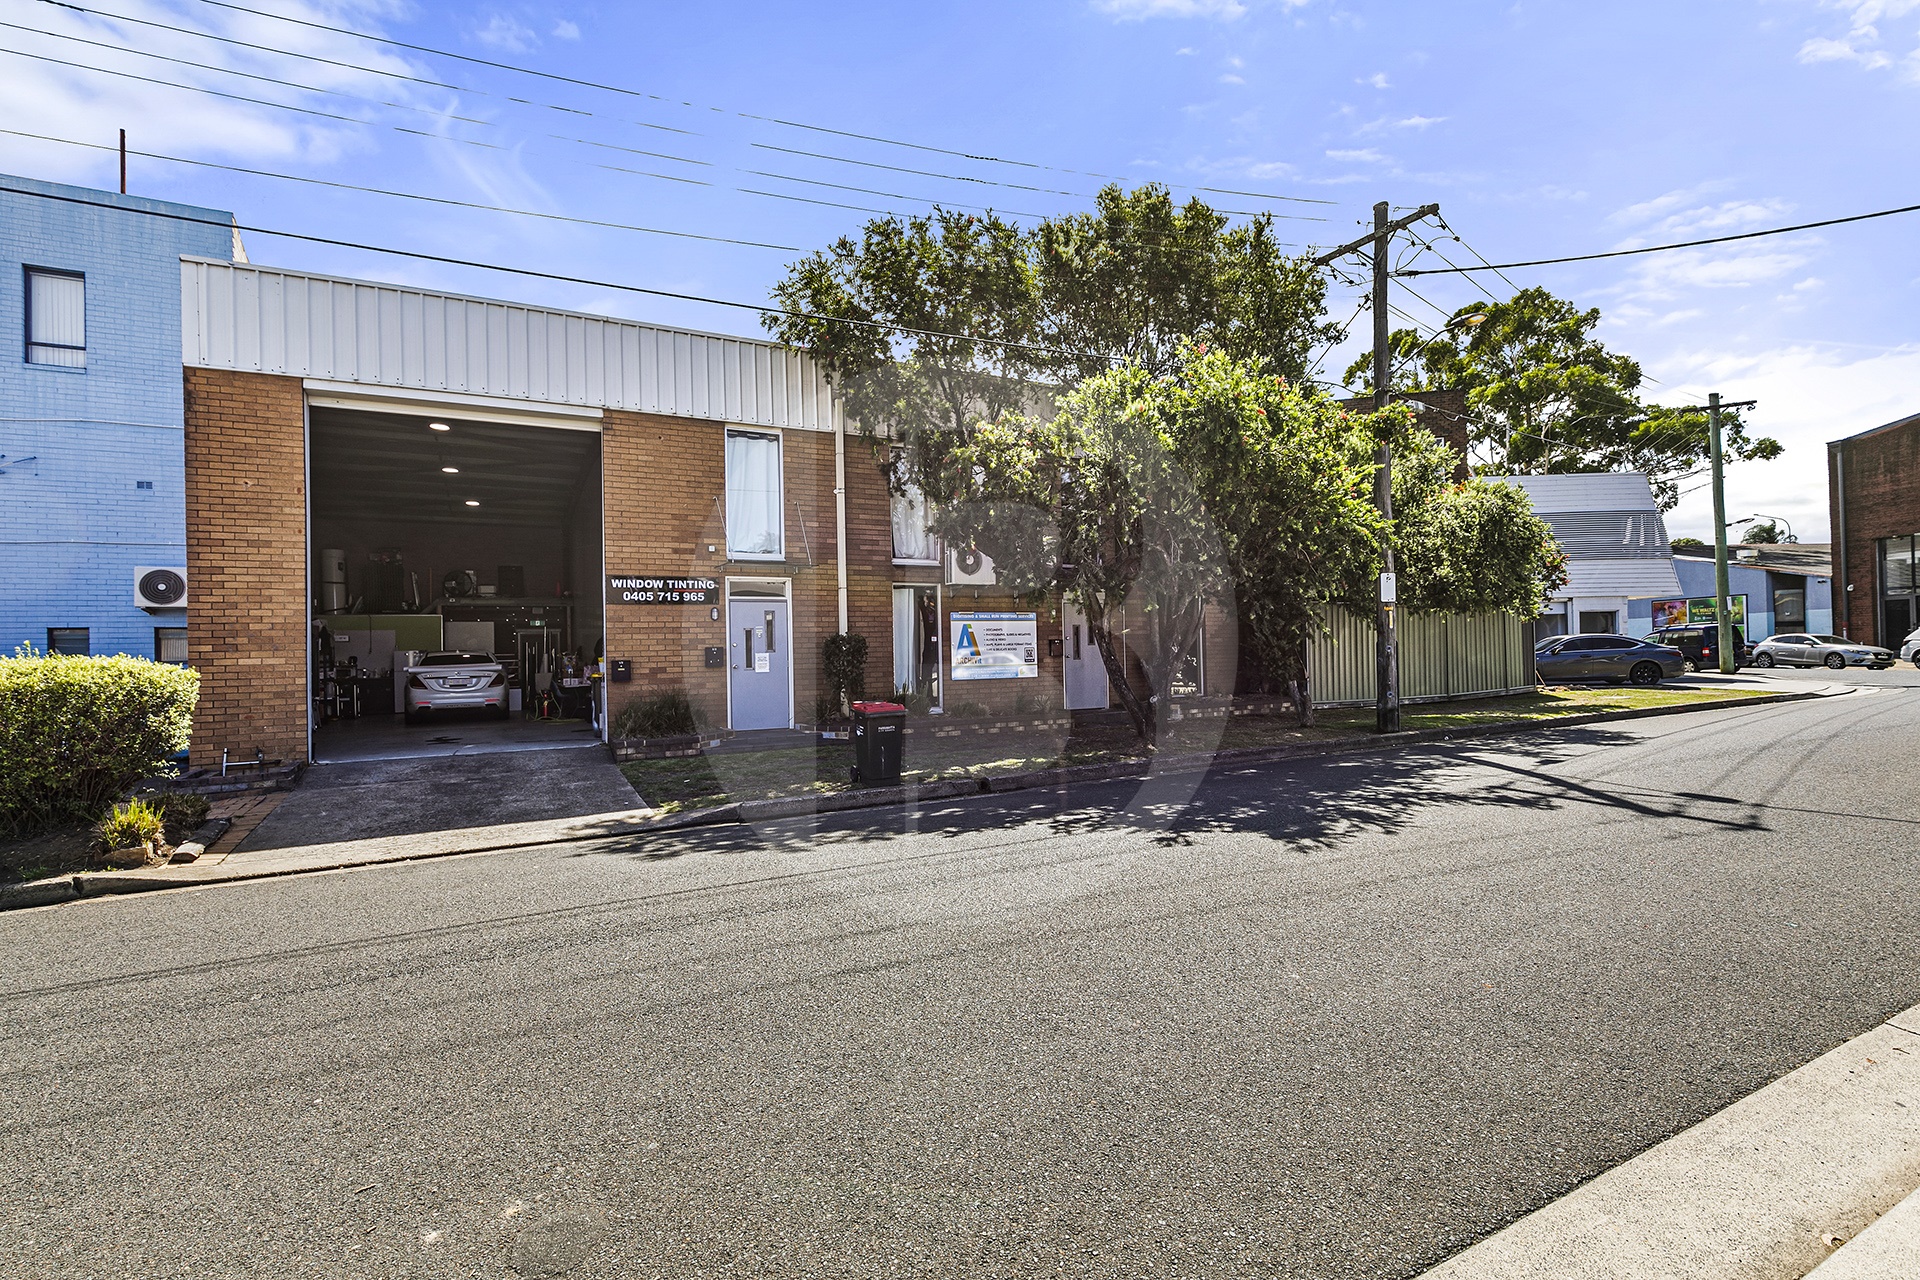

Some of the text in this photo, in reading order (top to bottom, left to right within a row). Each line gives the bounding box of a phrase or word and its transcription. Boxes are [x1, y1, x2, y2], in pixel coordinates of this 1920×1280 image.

[610, 579, 715, 590] WINDOW TINTING
[623, 592, 705, 601] 0405 715 965
